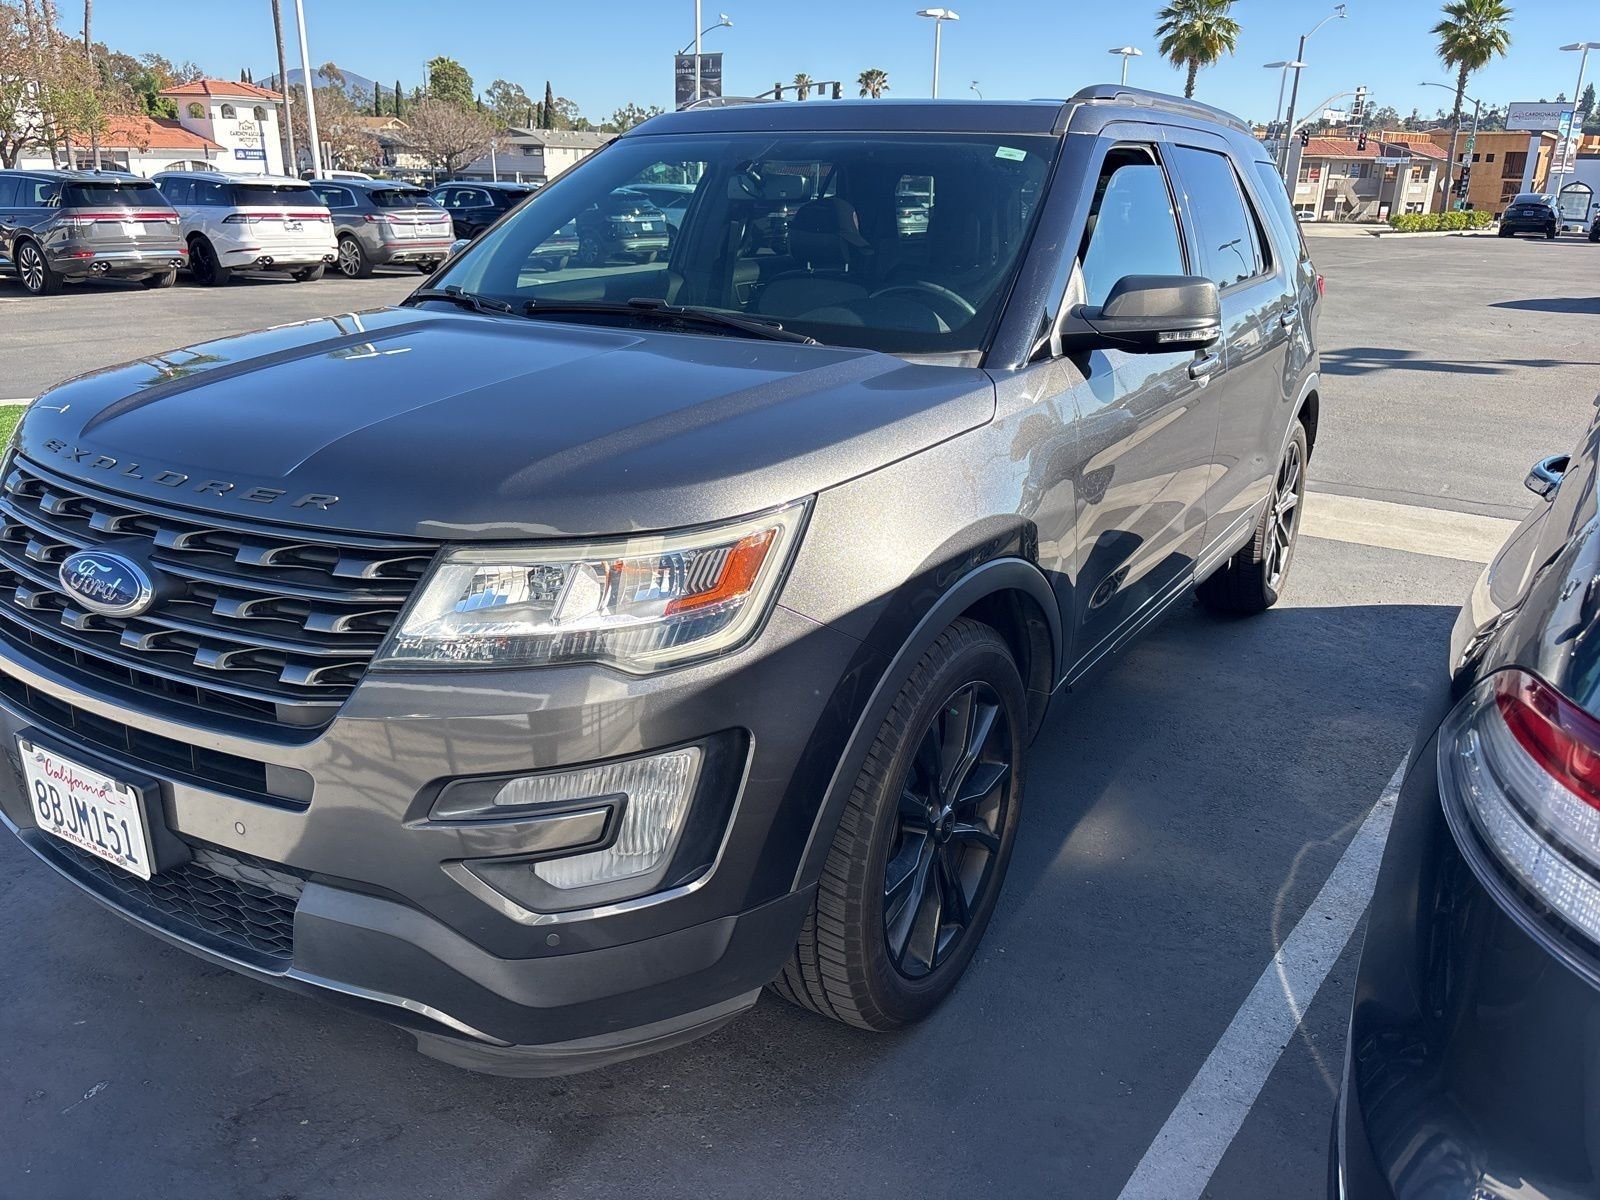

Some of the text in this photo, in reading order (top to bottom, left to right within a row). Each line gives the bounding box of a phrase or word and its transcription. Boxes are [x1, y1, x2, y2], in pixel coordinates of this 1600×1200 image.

[43, 437, 340, 511] EXPLORER
[70, 559, 122, 602] Ford
[44, 757, 116, 804] California
[34, 778, 139, 866] 8BJM151
